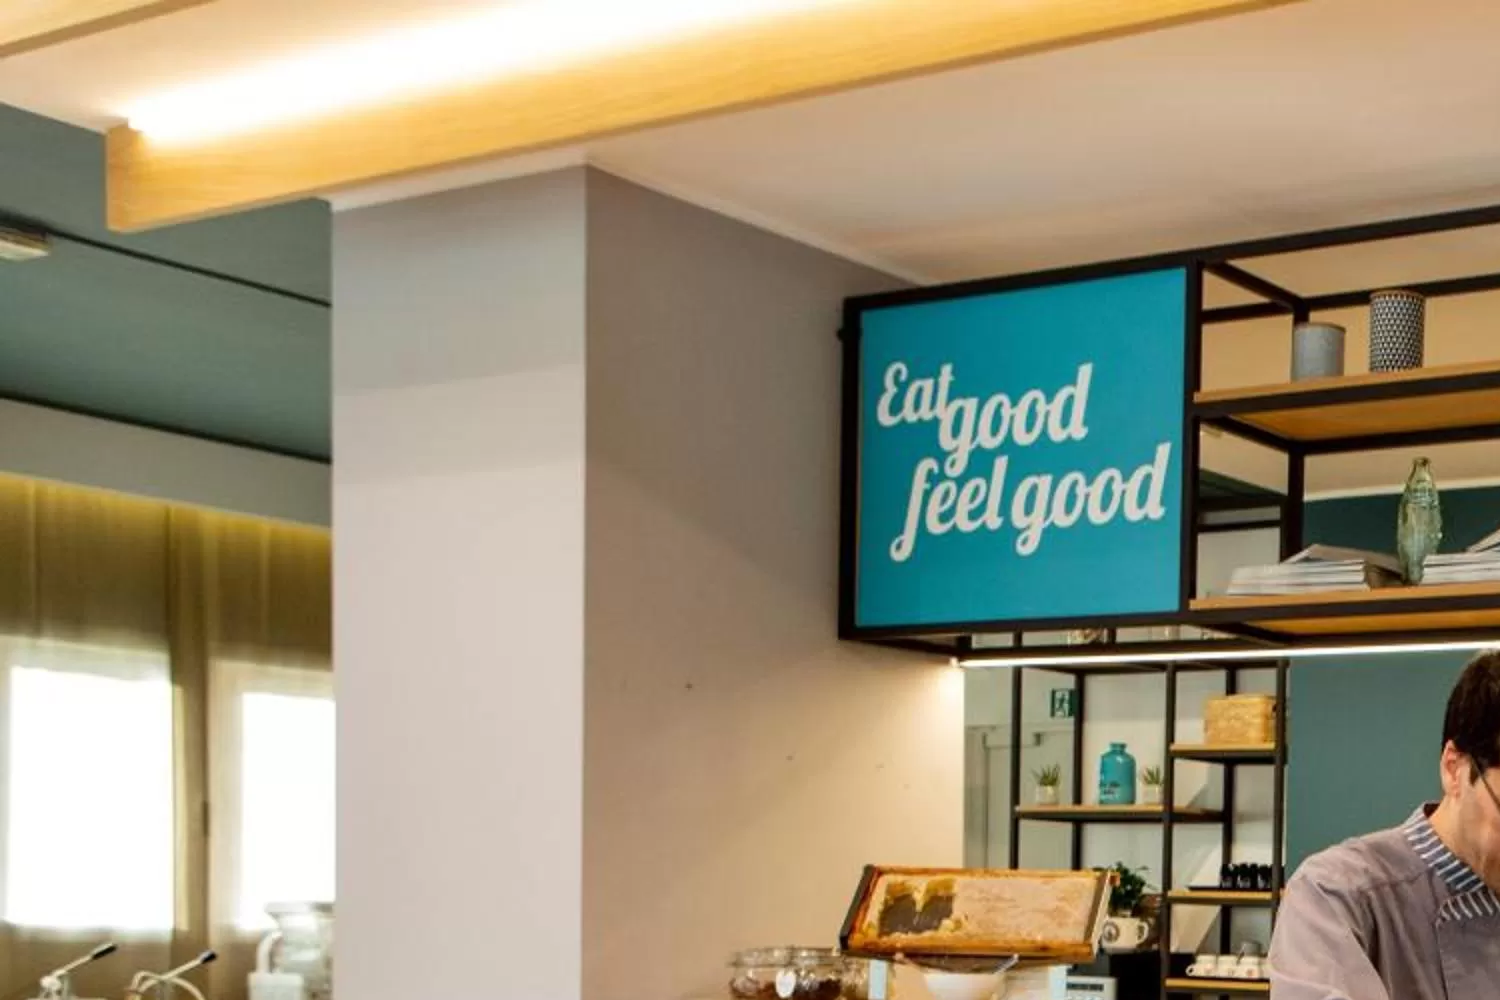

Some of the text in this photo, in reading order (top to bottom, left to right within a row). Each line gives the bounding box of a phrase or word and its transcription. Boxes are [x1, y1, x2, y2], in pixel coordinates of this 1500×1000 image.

[876, 361, 1093, 478] Eat good
[889, 441, 1172, 562] feel good
